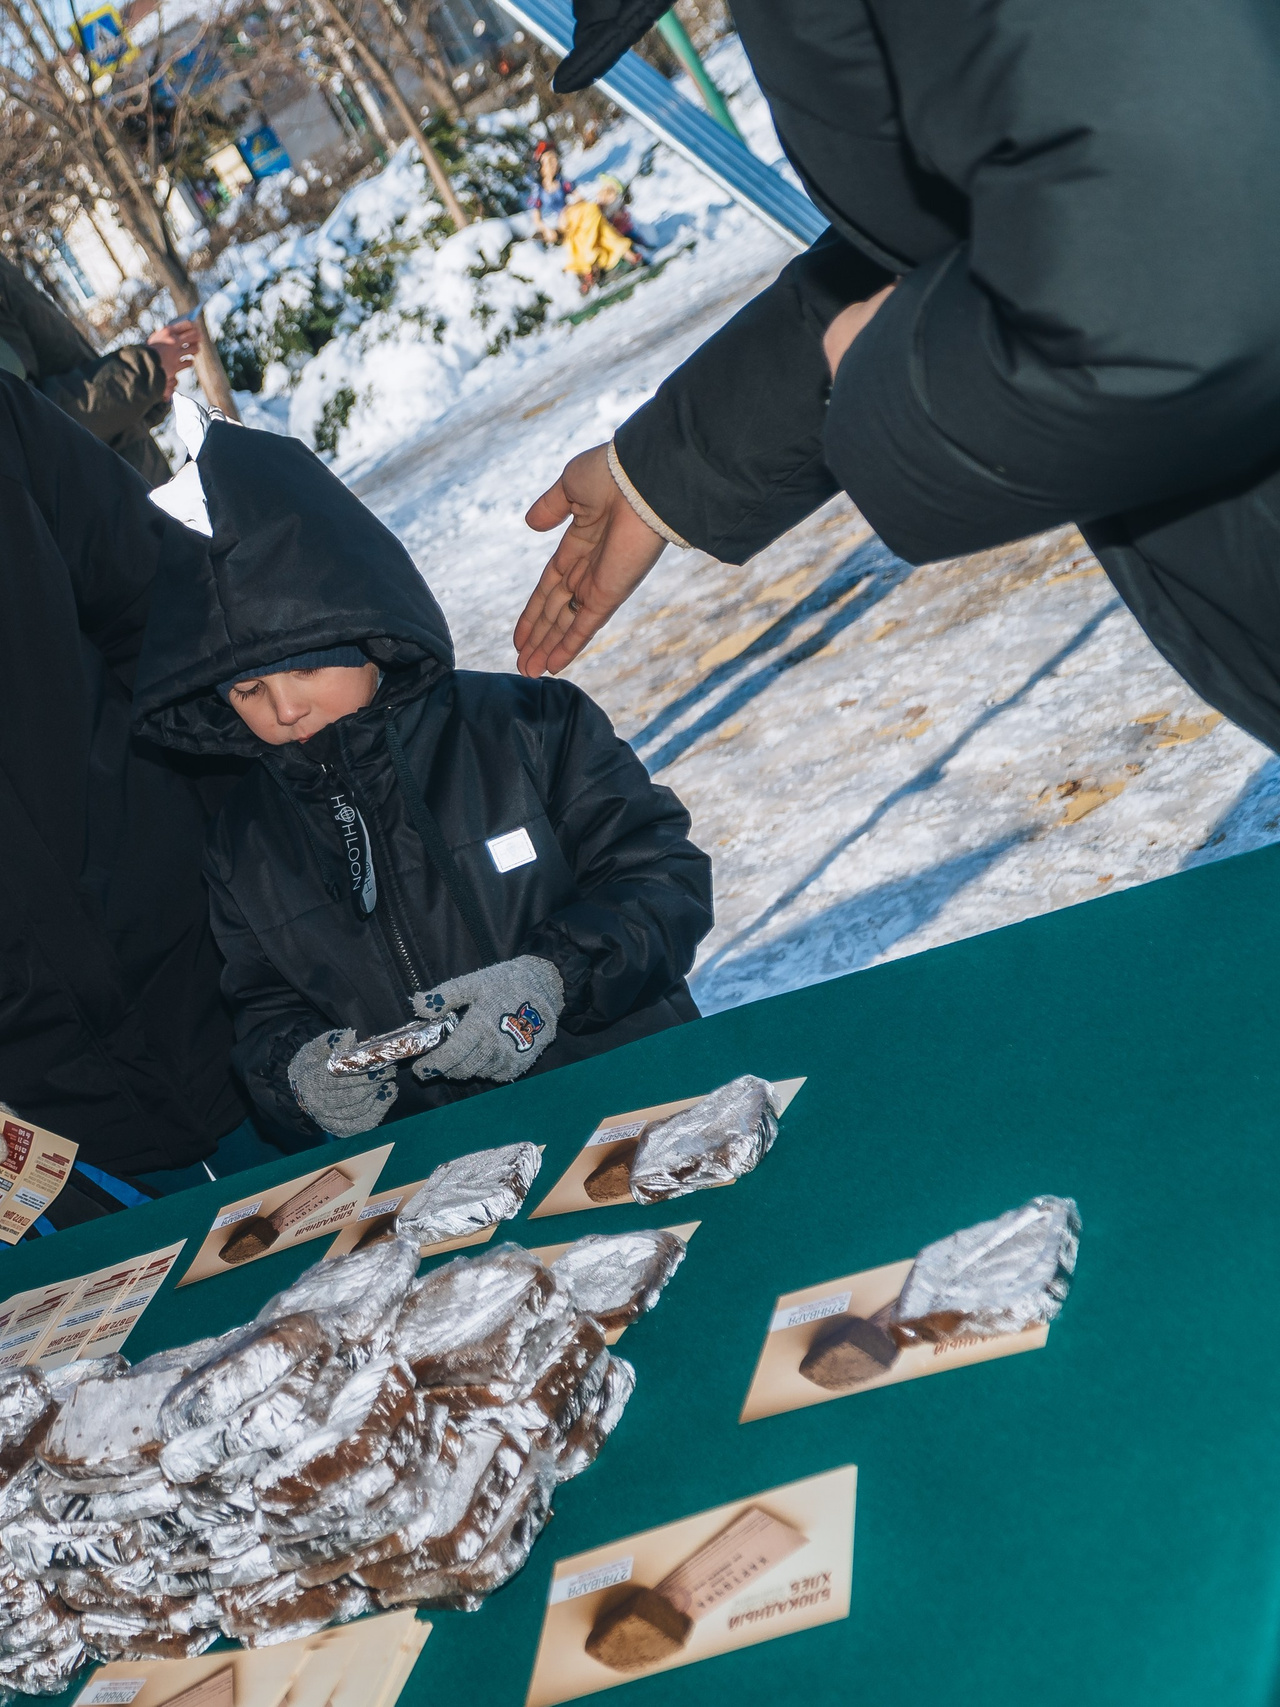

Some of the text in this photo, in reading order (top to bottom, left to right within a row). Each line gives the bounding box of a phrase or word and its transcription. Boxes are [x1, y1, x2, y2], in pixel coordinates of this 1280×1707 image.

[284, 1195, 330, 1228] КАРТОЧКА
[332, 1199, 358, 1216] ХЛЕБ
[294, 1208, 354, 1238] БЛОКАДНЫЙ
[789, 1571, 832, 1595] ХЛЕБ
[728, 1587, 832, 1633] БЛОКАДНЫЙ
